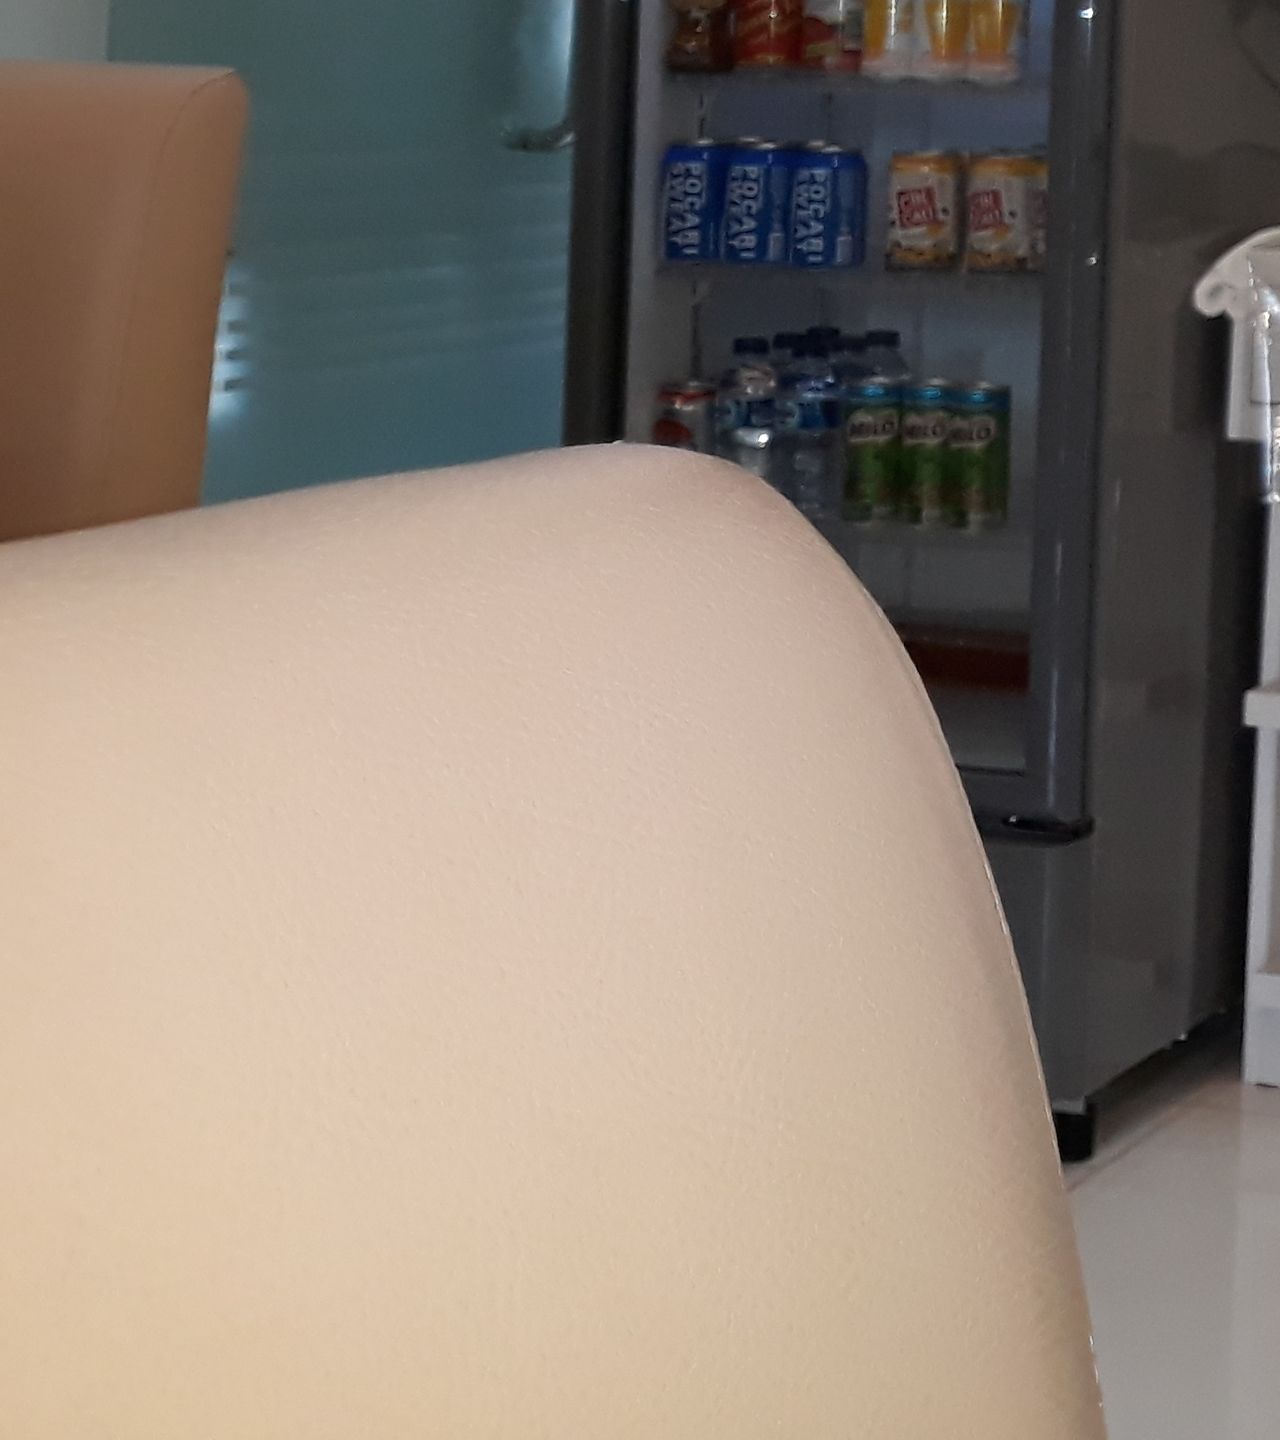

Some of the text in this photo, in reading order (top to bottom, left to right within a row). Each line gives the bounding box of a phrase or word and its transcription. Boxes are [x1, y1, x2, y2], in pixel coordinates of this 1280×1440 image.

[681, 162, 704, 256] POCARI
[739, 165, 761, 260] POCARI
[807, 168, 826, 265] POCARI
